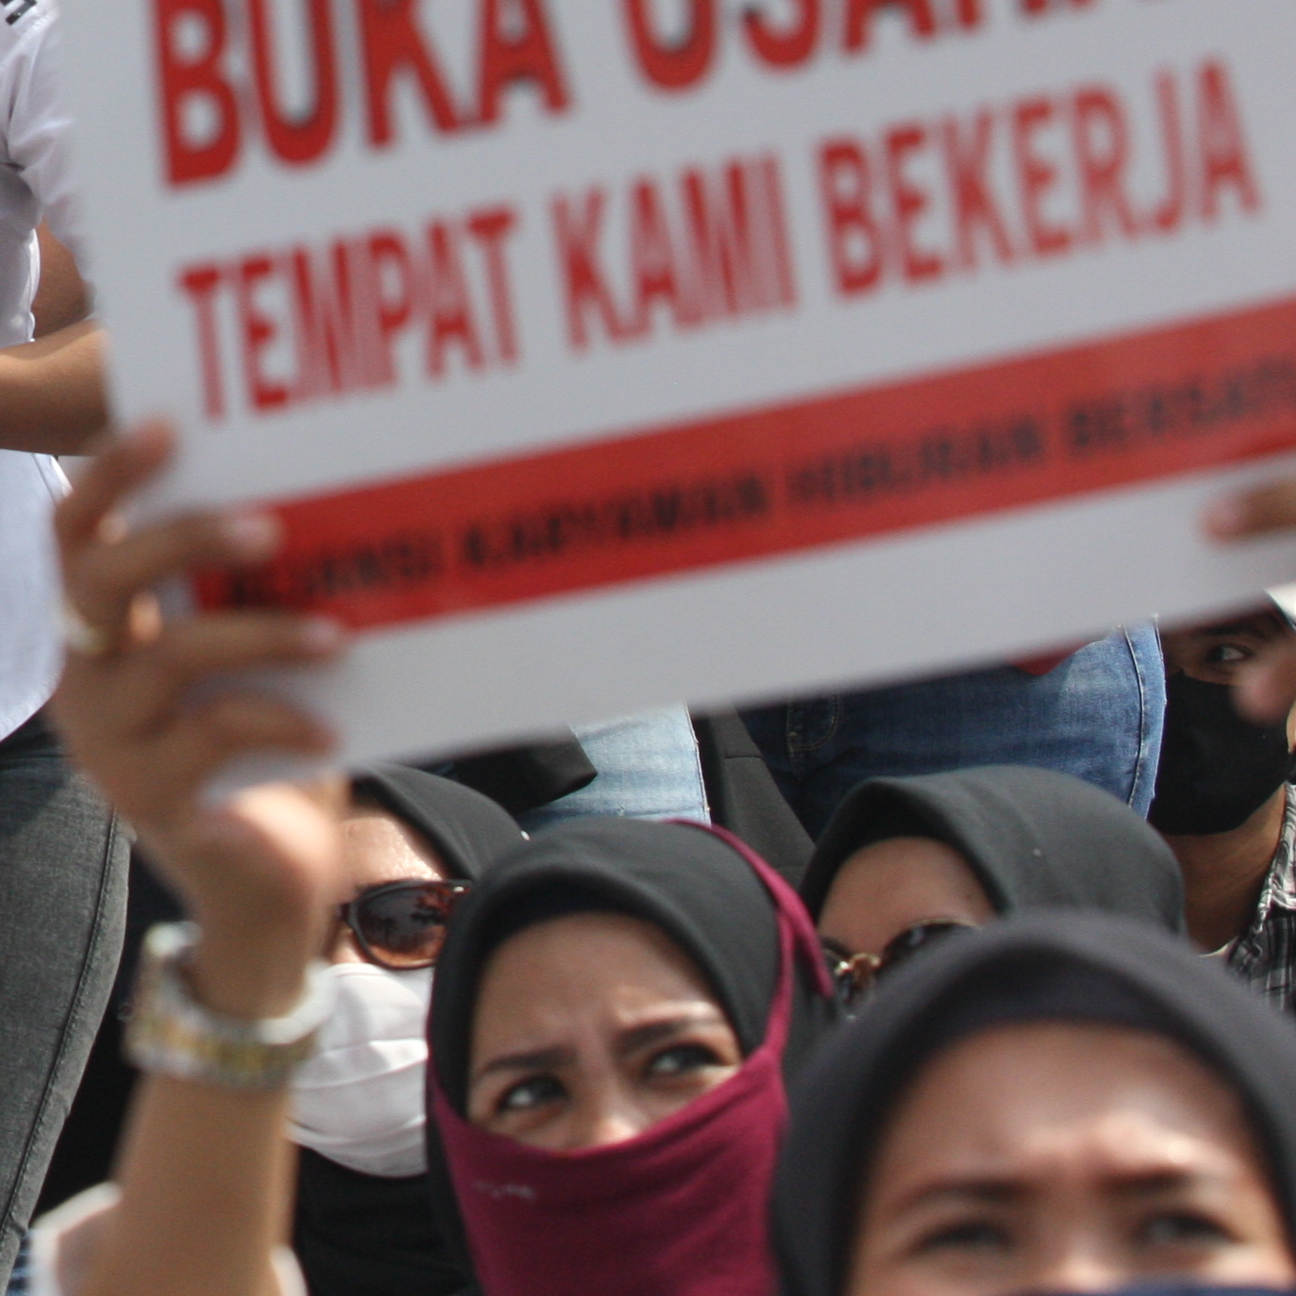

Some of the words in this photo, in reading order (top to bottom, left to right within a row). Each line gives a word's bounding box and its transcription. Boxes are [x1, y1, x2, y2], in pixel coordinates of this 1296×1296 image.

[176, 202, 520, 422] TEMPAT
[554, 156, 803, 352] KAMI
[820, 58, 1260, 296] BEKERJA
